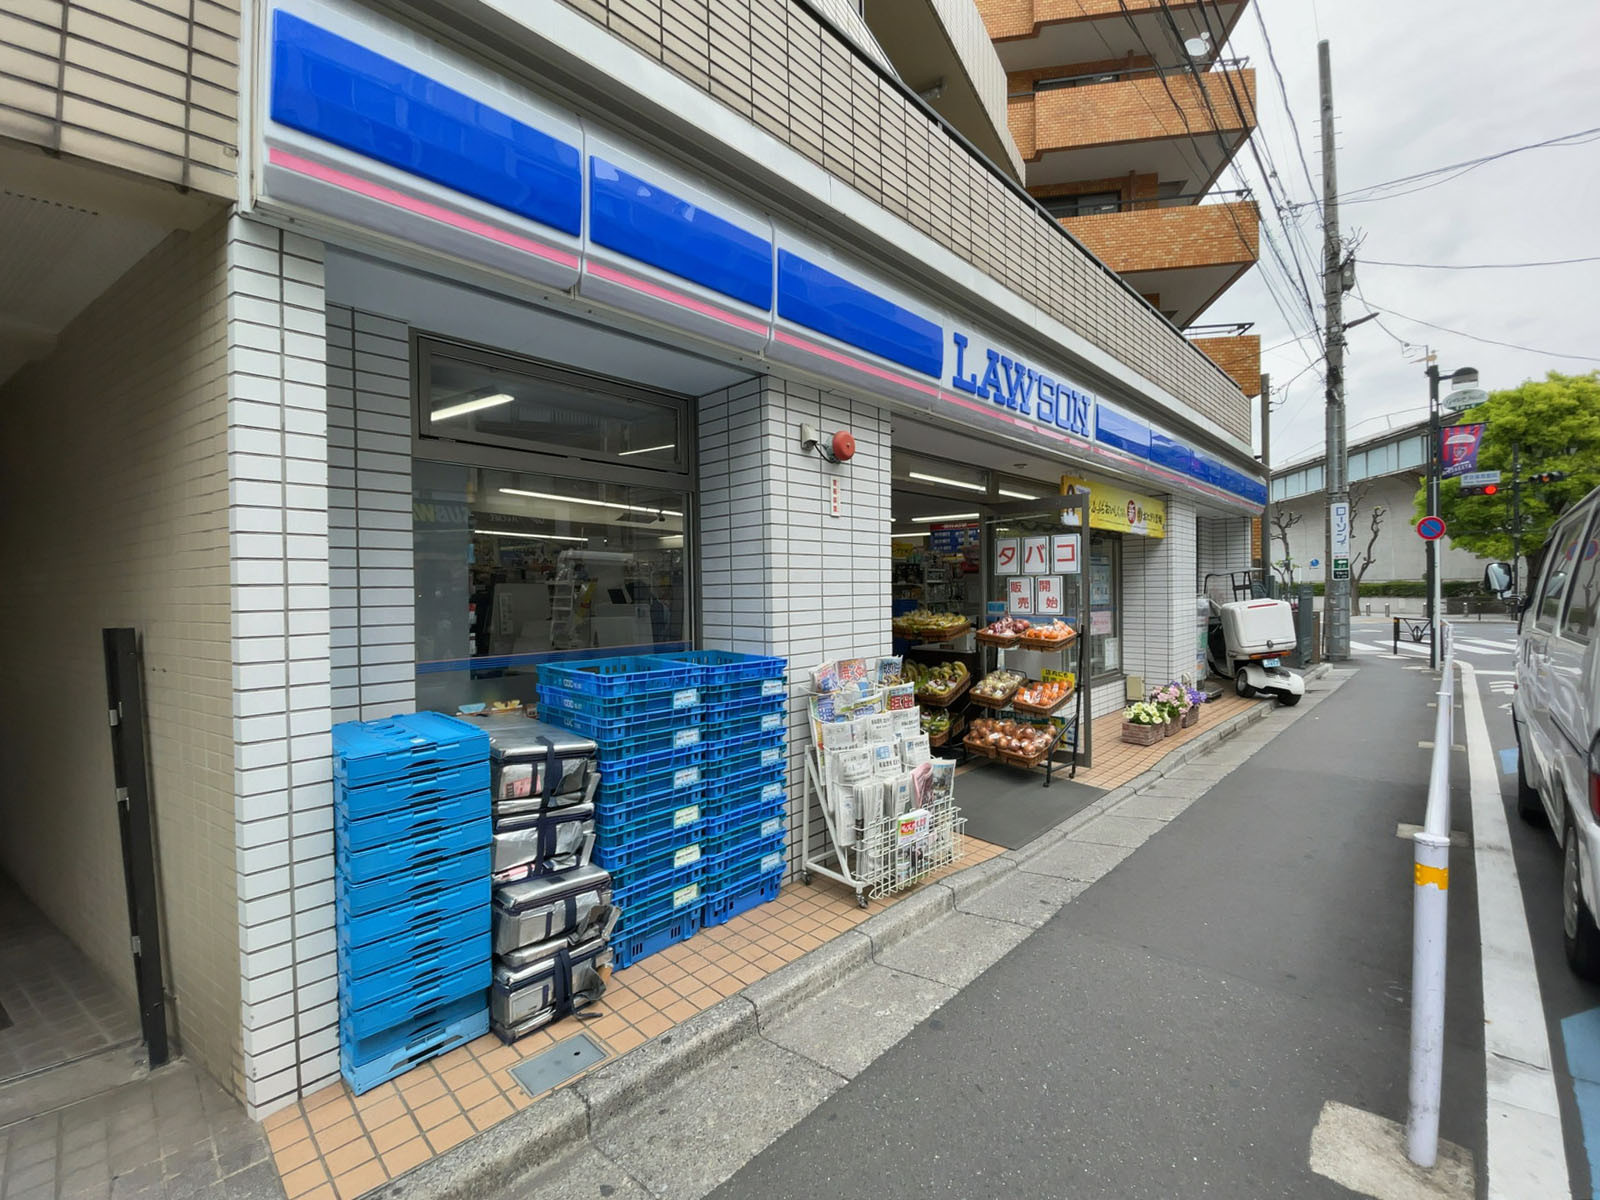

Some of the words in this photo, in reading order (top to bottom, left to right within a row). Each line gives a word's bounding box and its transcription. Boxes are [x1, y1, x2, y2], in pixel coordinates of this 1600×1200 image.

[953, 331, 1090, 438] LAWSON
[1335, 506, 1347, 545] ローソン
[998, 543, 1076, 566] タバコ
